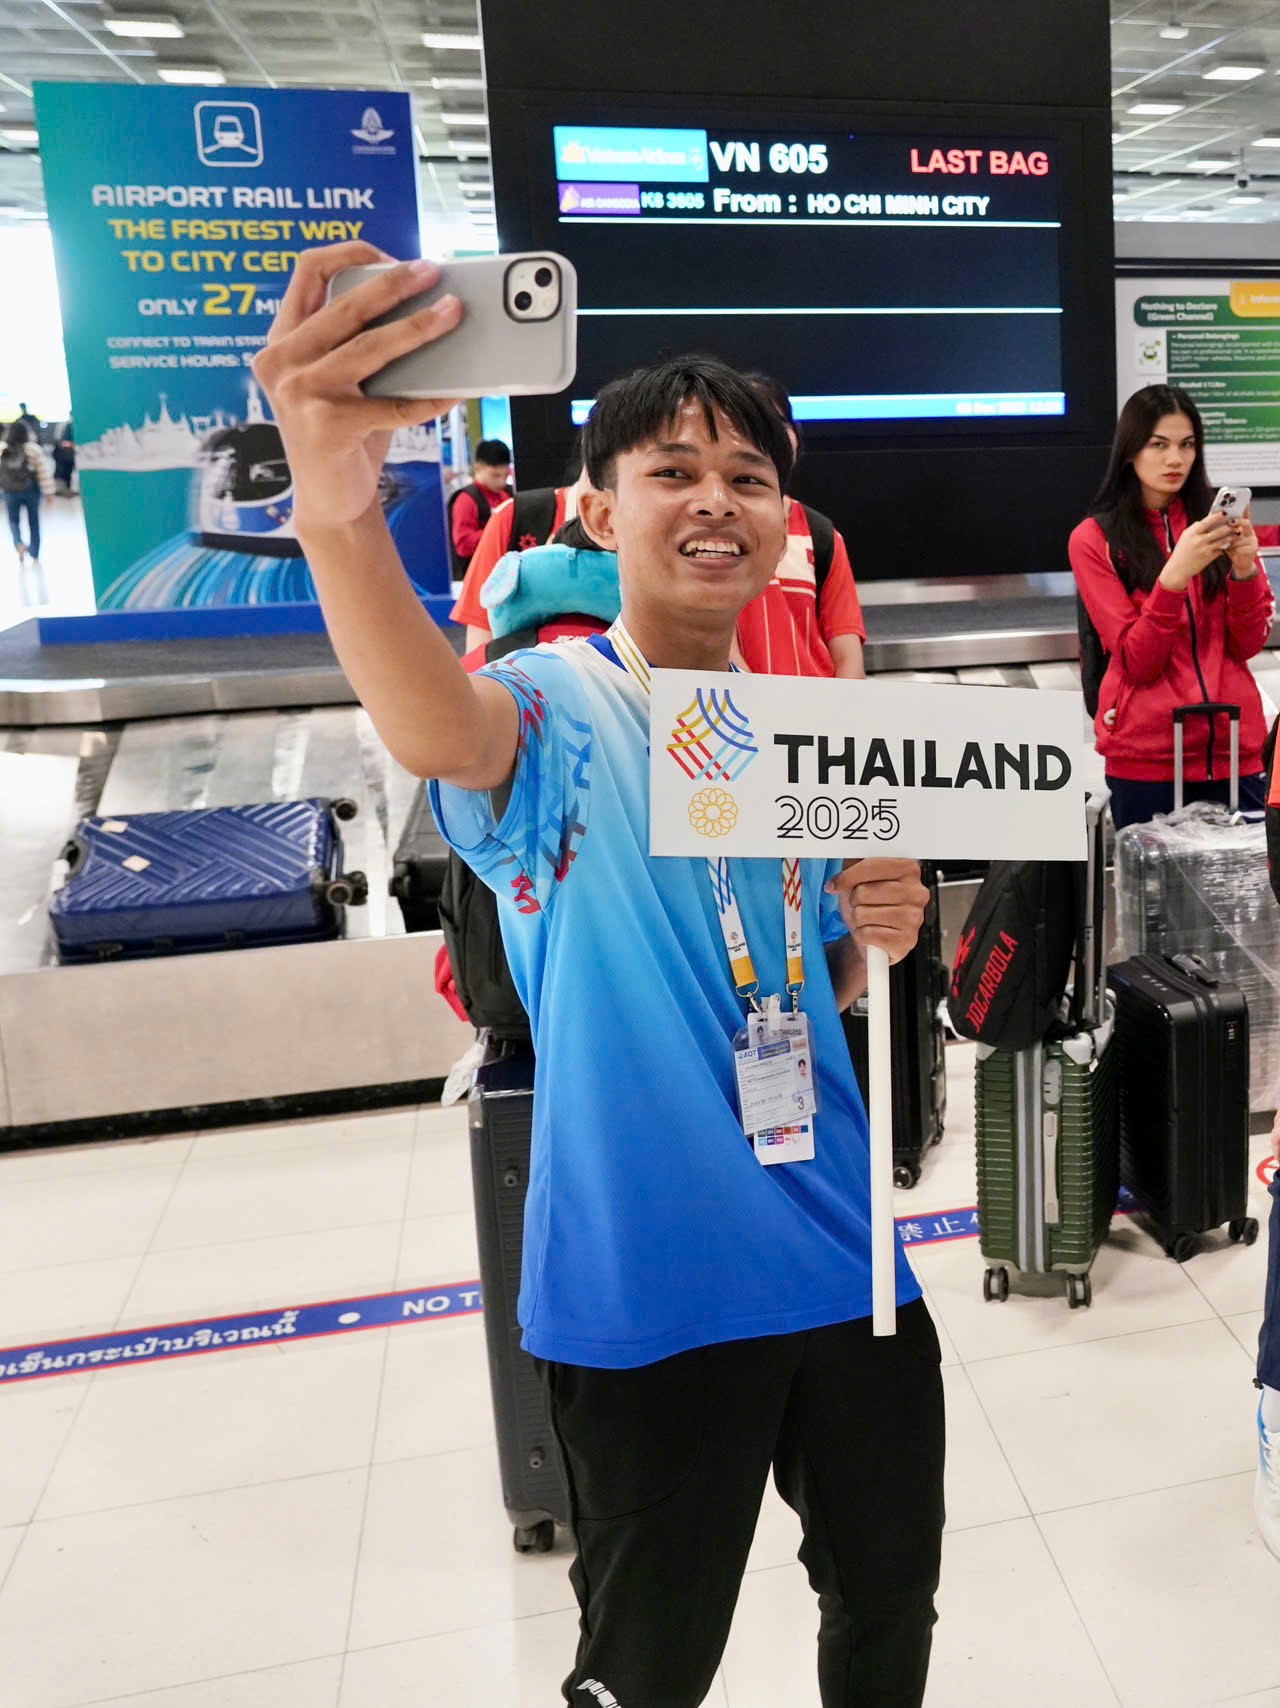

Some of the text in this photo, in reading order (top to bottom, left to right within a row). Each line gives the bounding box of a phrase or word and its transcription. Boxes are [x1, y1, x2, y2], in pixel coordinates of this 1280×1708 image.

[709, 141, 828, 174] VN 605
[911, 148, 1049, 175] LAST BAG
[92, 184, 375, 209] AIRPORT RAIL LINK
[713, 188, 781, 213] From
[808, 194, 989, 216] HO CHI MINH CITY
[108, 219, 363, 240] THE FASTEST WAY
[122, 252, 299, 272] TO CITY CEN
[138, 283, 284, 316] ONLY 27 MI
[1141, 302, 1218, 312] Nothing to Declare
[172, 336, 190, 348] TO
[192, 336, 234, 348] TRAIN
[235, 335, 268, 348] STAT
[109, 355, 178, 369] SERVICE
[181, 354, 241, 368] HOURS:
[774, 732, 1073, 792] THAILAND
[775, 795, 901, 841] 2025
[402, 1295, 450, 1316] NO
